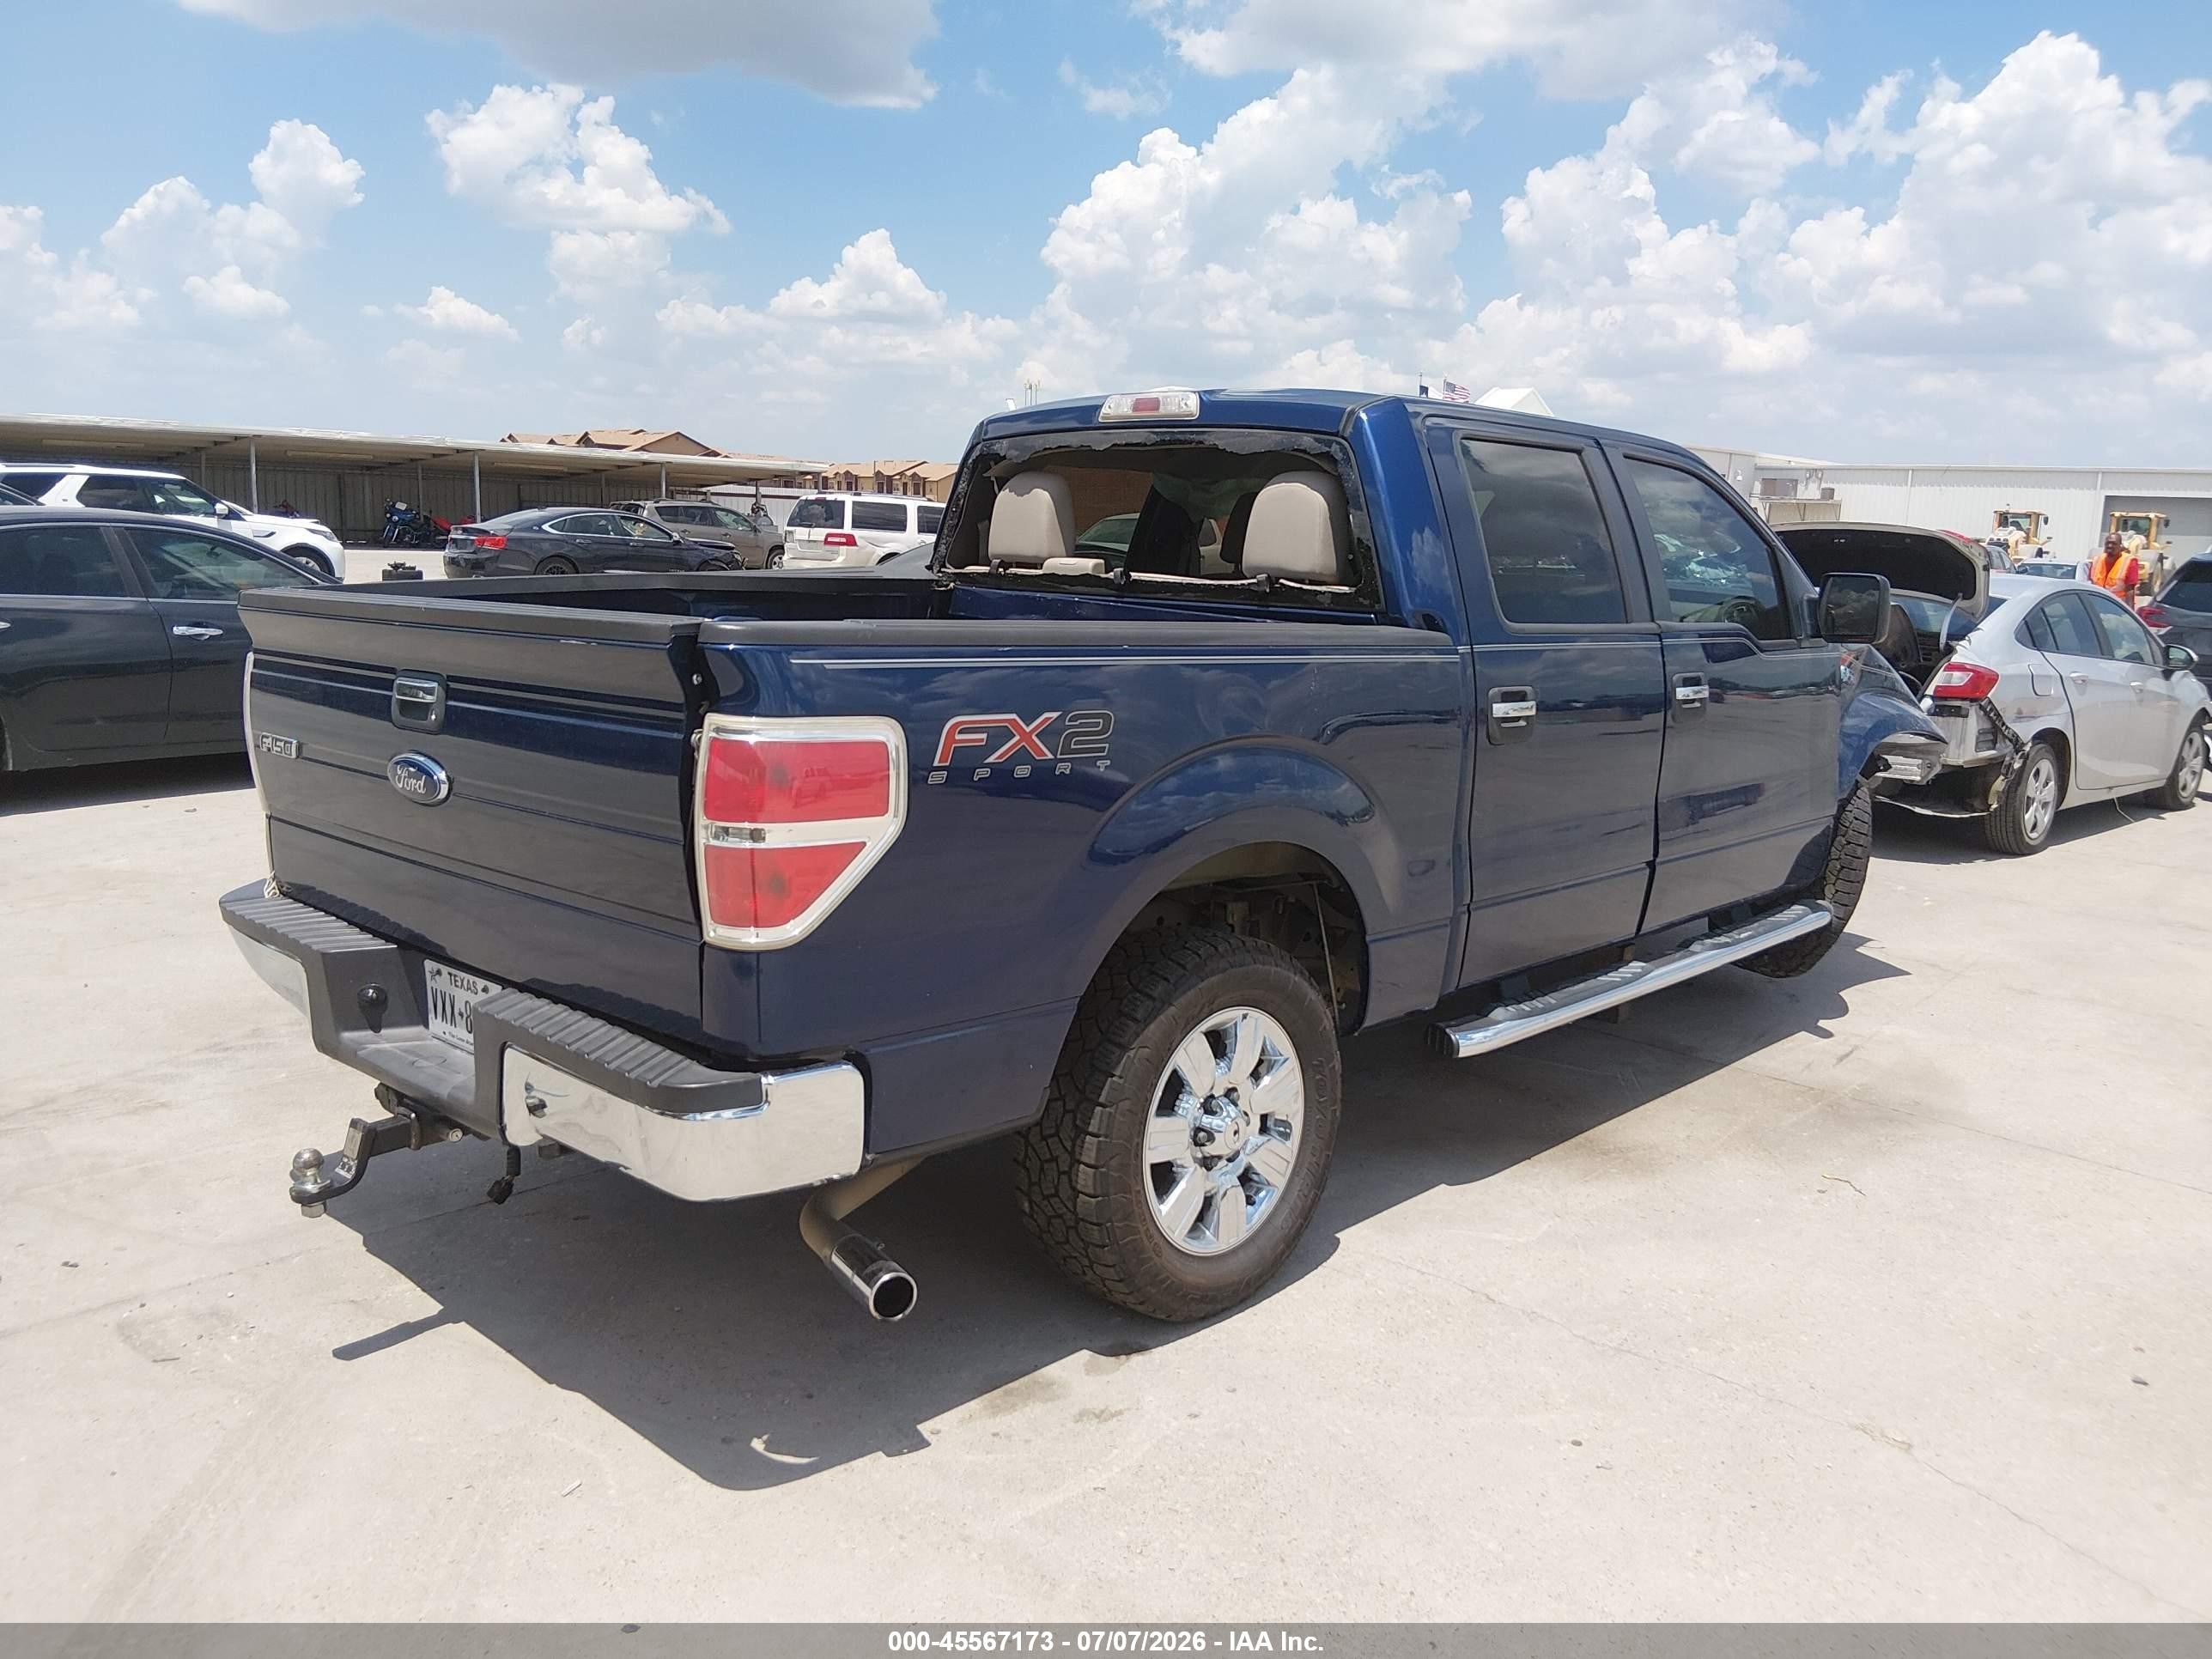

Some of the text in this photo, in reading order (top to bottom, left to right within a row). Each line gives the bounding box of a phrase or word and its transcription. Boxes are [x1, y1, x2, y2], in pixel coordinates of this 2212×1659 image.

[260, 732, 295, 757] F-150
[933, 710, 1115, 767] FX2
[395, 764, 427, 793] Ford
[927, 760, 1110, 785] SPORT
[447, 971, 478, 996] TEXAS
